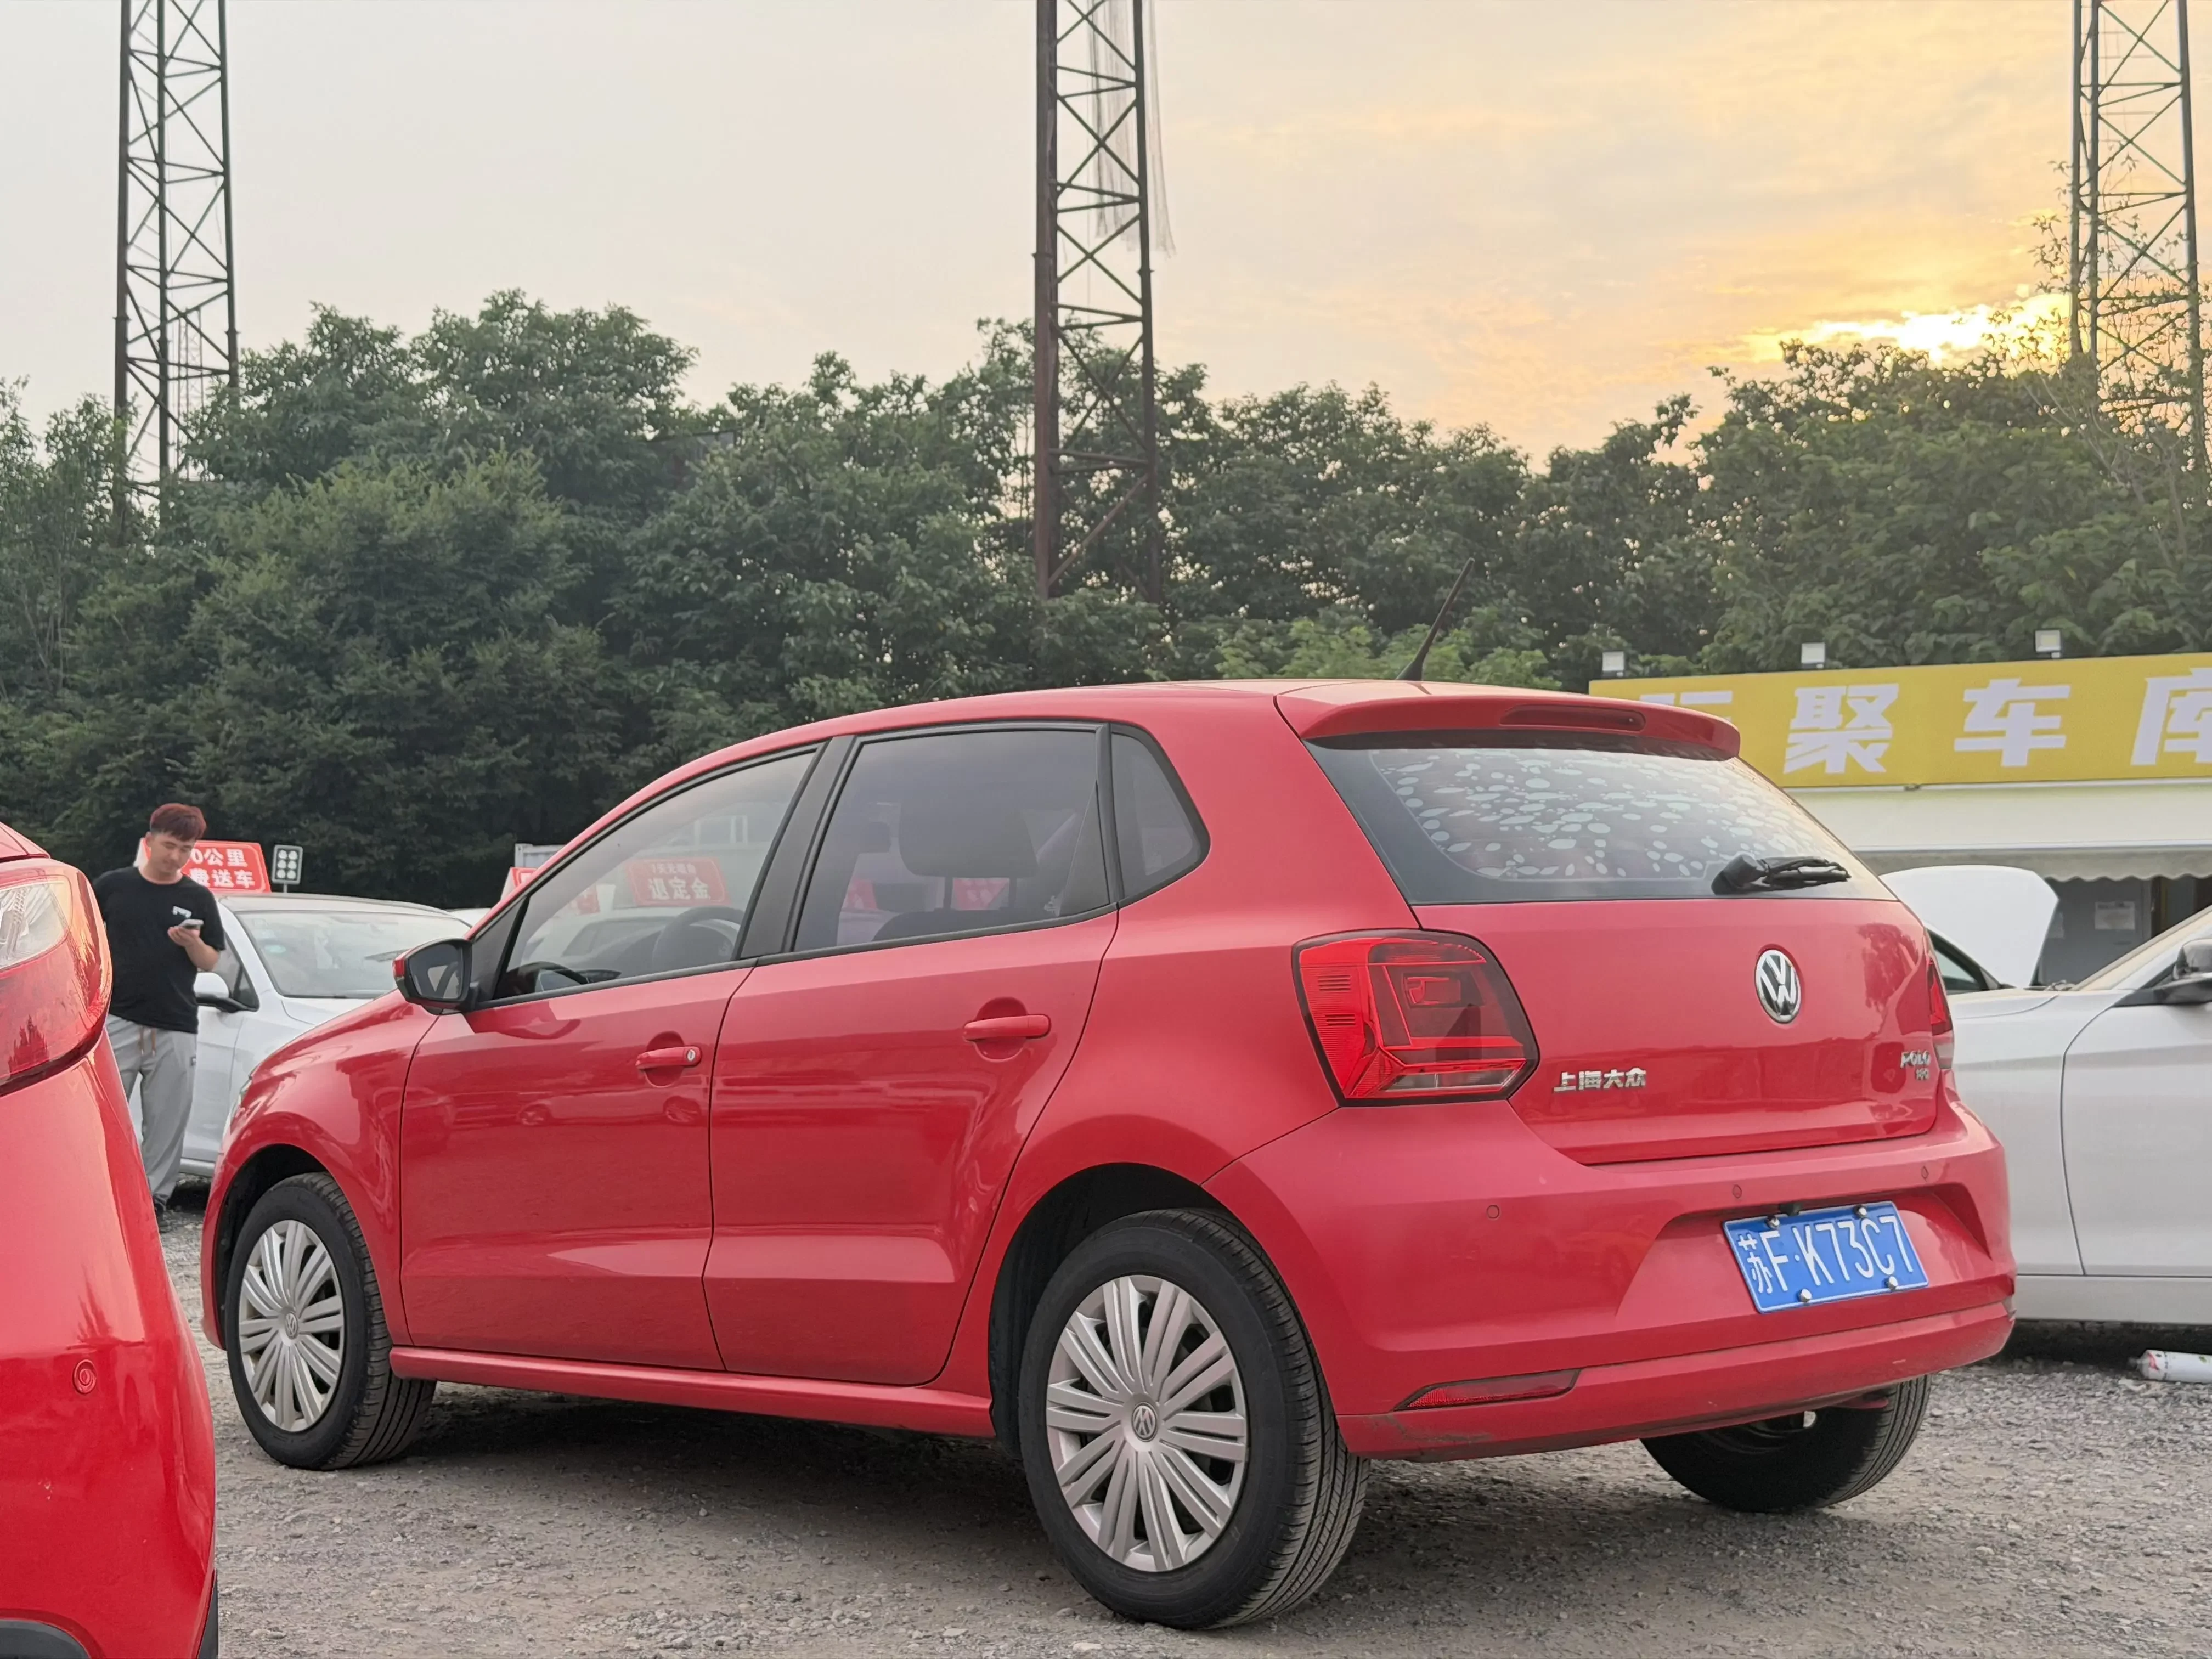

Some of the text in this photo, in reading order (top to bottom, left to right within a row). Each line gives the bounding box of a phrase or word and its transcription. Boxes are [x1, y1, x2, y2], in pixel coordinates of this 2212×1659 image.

[1638, 668, 2212, 774] 聚车库
[1553, 1068, 1646, 1092] 上海大众
